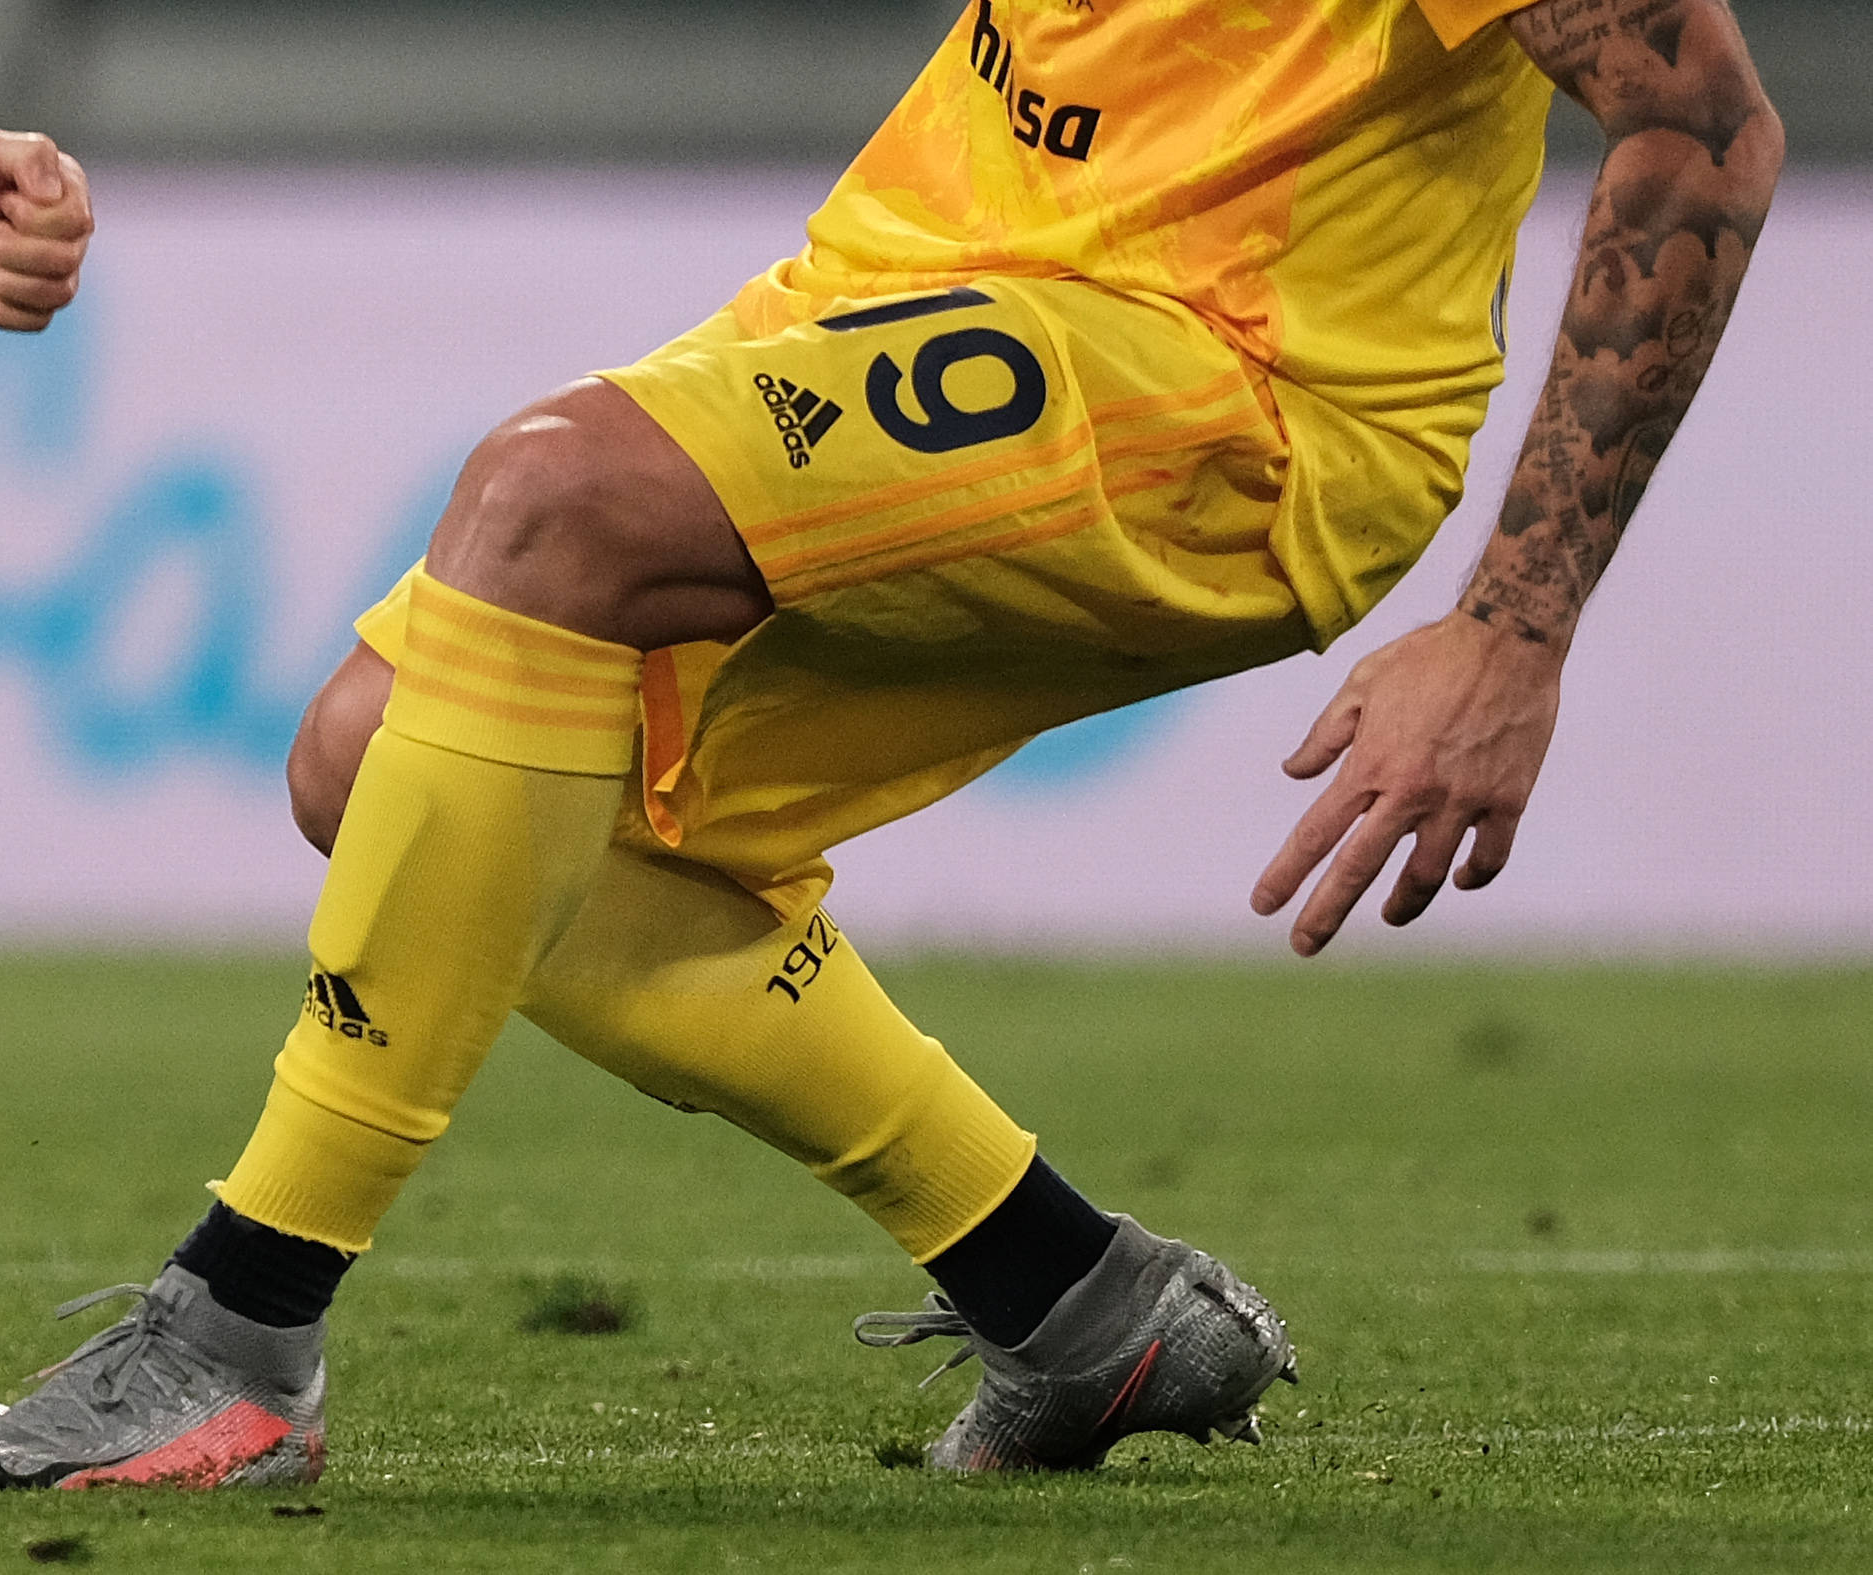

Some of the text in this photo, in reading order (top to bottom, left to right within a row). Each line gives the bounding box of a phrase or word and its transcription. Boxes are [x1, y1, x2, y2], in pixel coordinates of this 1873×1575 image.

[815, 286, 1047, 455] 19
[753, 372, 811, 469] adidas
[305, 996, 388, 1047] didas
